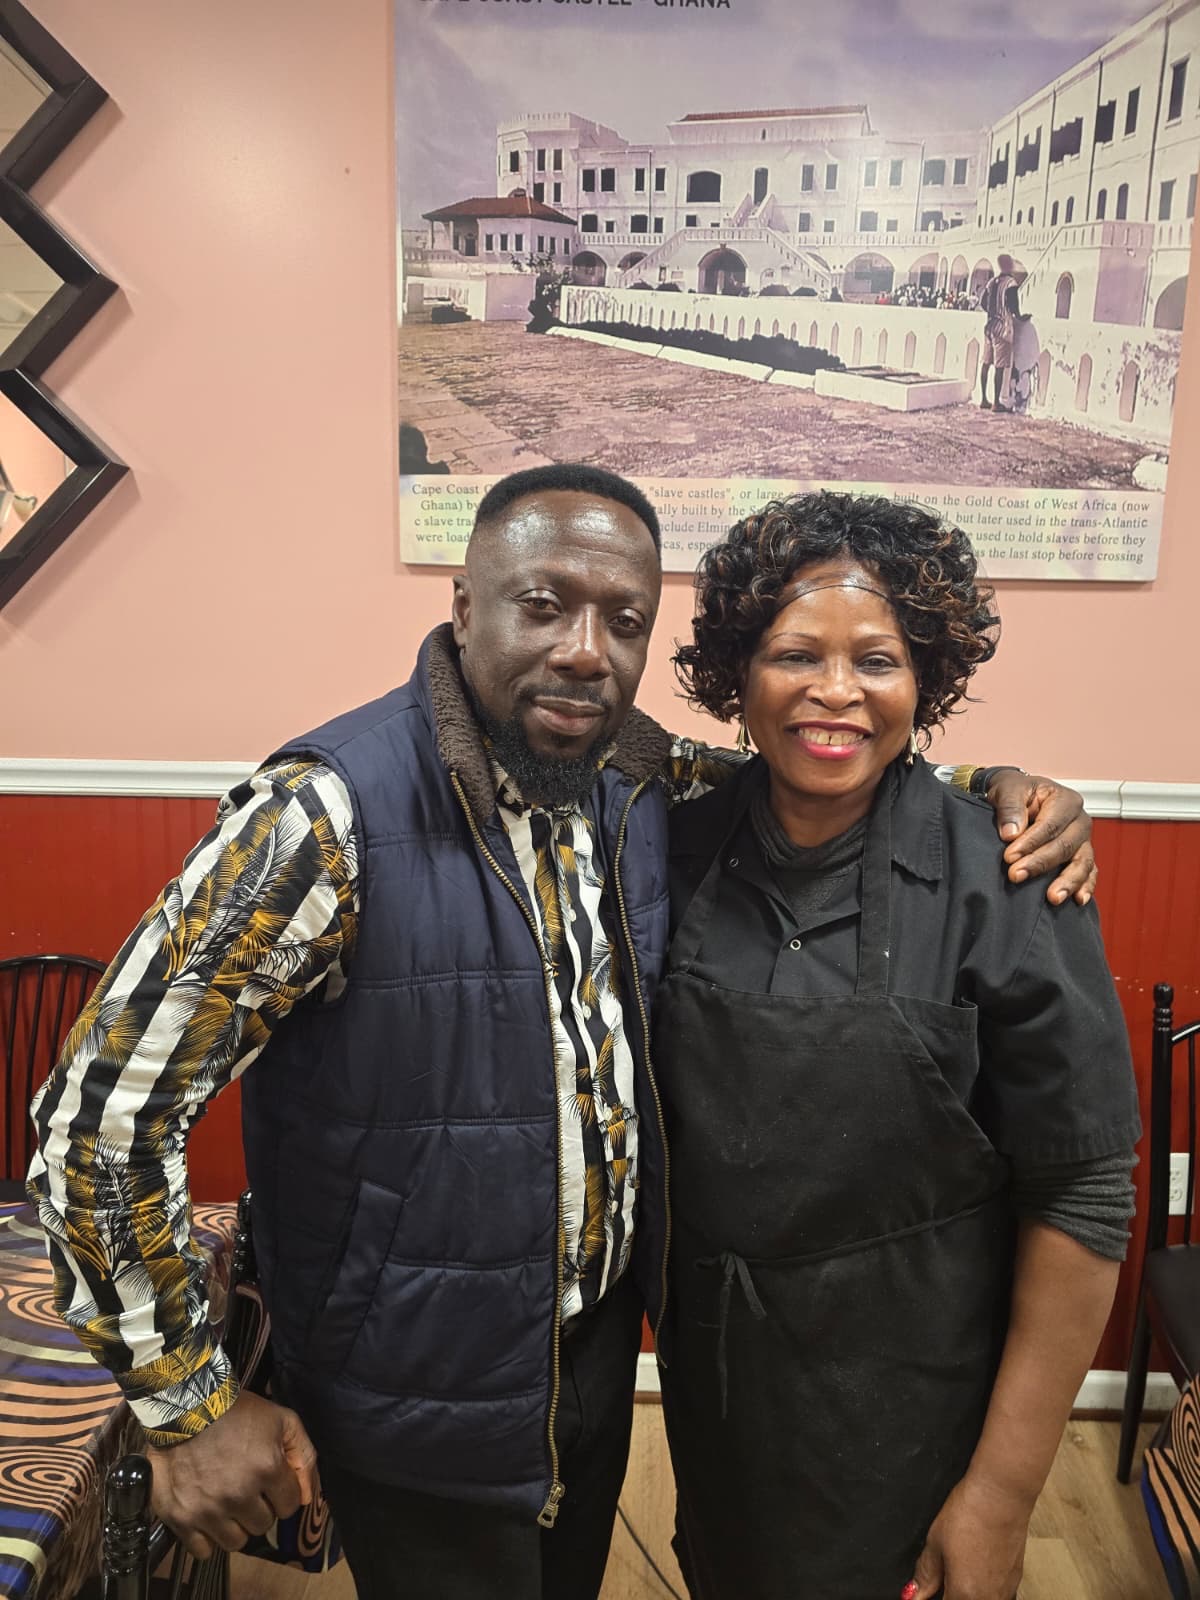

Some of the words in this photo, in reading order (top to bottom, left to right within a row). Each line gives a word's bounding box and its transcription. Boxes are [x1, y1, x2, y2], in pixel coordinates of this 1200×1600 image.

[412, 484, 442, 496] Cape
[446, 484, 479, 495] Coast
[739, 490, 752, 499] or
[924, 495, 938, 505] on
[943, 494, 960, 505] the
[965, 496, 993, 508] Gold
[998, 496, 1030, 509] Coast
[1034, 498, 1049, 509] of
[1051, 499, 1079, 510] West
[1082, 500, 1118, 511] Africa
[1121, 500, 1151, 513] (now
[421, 499, 463, 512] Ghana)
[681, 503, 708, 515] built
[711, 504, 725, 519] by
[728, 505, 746, 516] the
[956, 513, 974, 525] but
[977, 515, 1002, 526] later
[1006, 516, 1032, 528] used
[1035, 515, 1046, 527] in
[1049, 515, 1067, 528] the
[1070, 517, 1148, 529] trans-Atlantic
[416, 533, 443, 542] were
[446, 531, 470, 543] load
[989, 547, 1006, 559] the
[1009, 548, 1029, 560] last
[1031, 549, 1055, 562] stop
[1058, 549, 1094, 561] before
[1097, 551, 1144, 564] crossing
[423, 516, 453, 526] slave
[697, 521, 730, 534] Elmin
[976, 531, 1001, 542] used
[1004, 532, 1015, 543] to
[1018, 531, 1043, 543] hold
[1045, 532, 1081, 544] slaves
[1083, 533, 1119, 545] before
[1122, 533, 1146, 548] they
